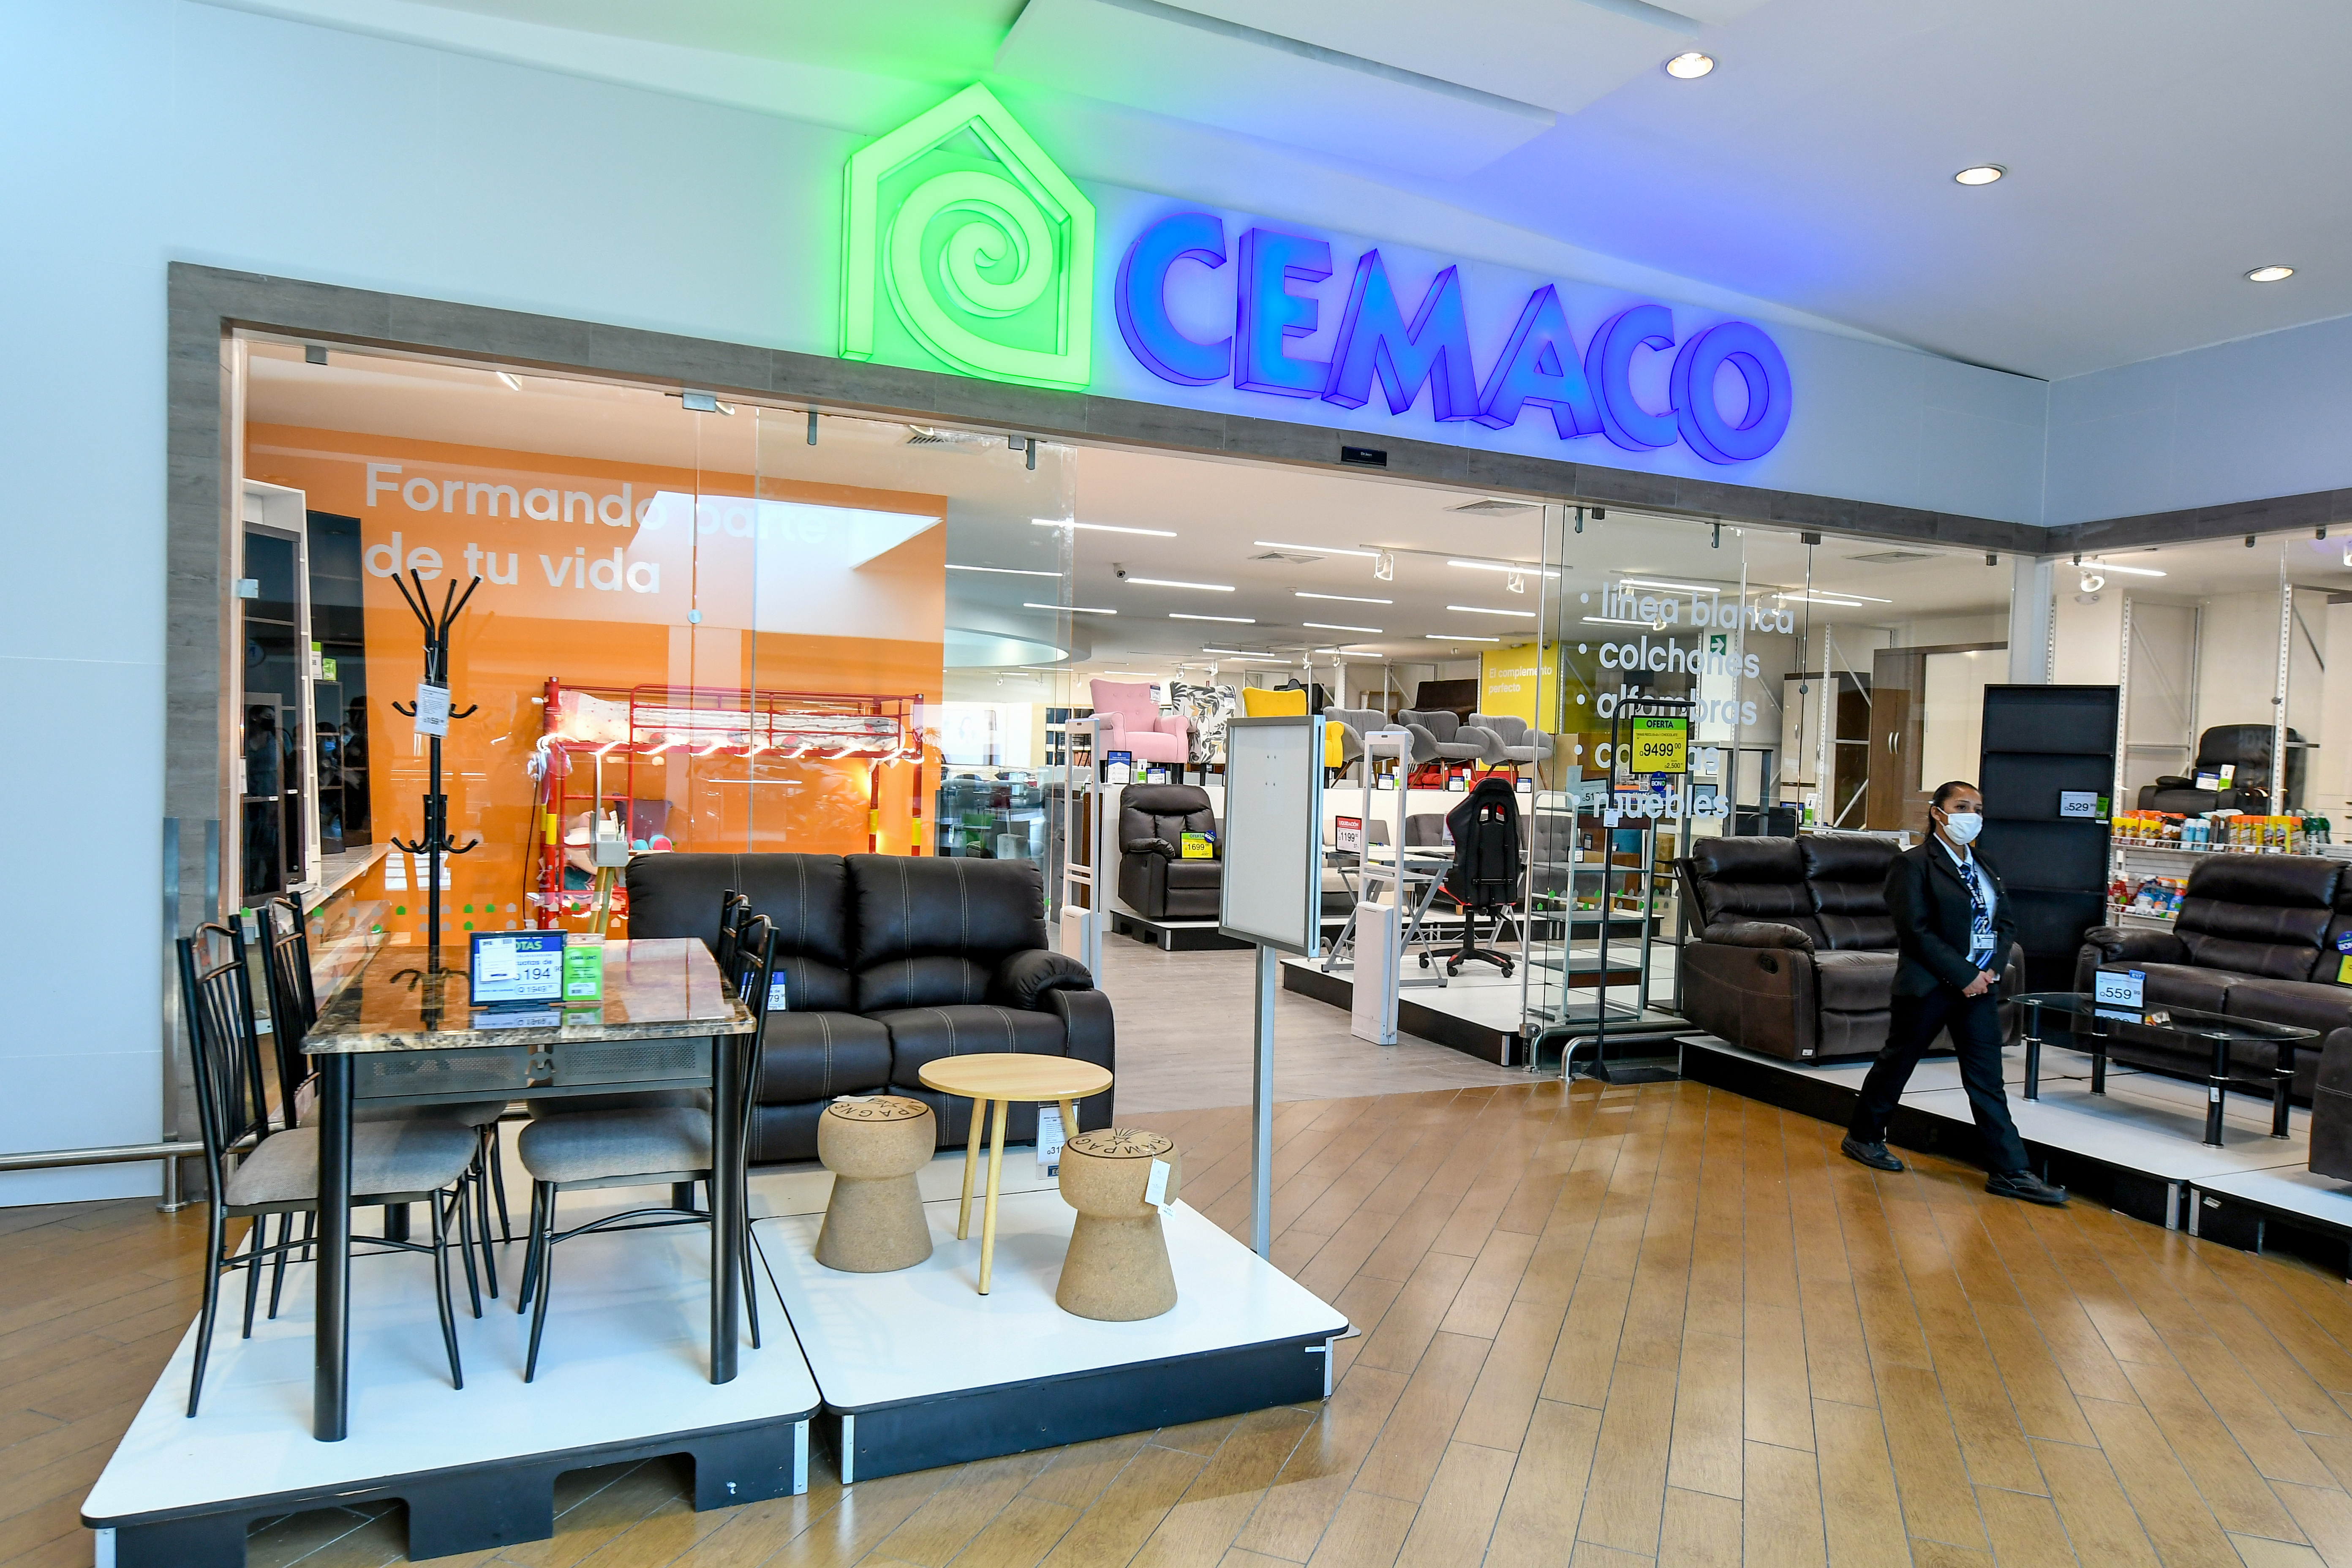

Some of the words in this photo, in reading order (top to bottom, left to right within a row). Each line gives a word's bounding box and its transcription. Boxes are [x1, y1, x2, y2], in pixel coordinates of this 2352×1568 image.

[1114, 212, 1793, 466] CEMACO
[367, 463, 668, 531] Formando
[688, 503, 828, 547] parte
[365, 531, 443, 580] de
[463, 543, 518, 585] tu
[539, 547, 660, 593] vida
[1690, 591, 1794, 634] blanca
[1489, 667, 1496, 678] El
[1599, 635, 1760, 678] colchones
[1488, 682, 1521, 696] perfecto
[1646, 720, 1674, 728] OFERTA
[1592, 784, 1729, 819] muebles
[516, 940, 543, 950] OTAS
[2100, 987, 2132, 1000] Q559
